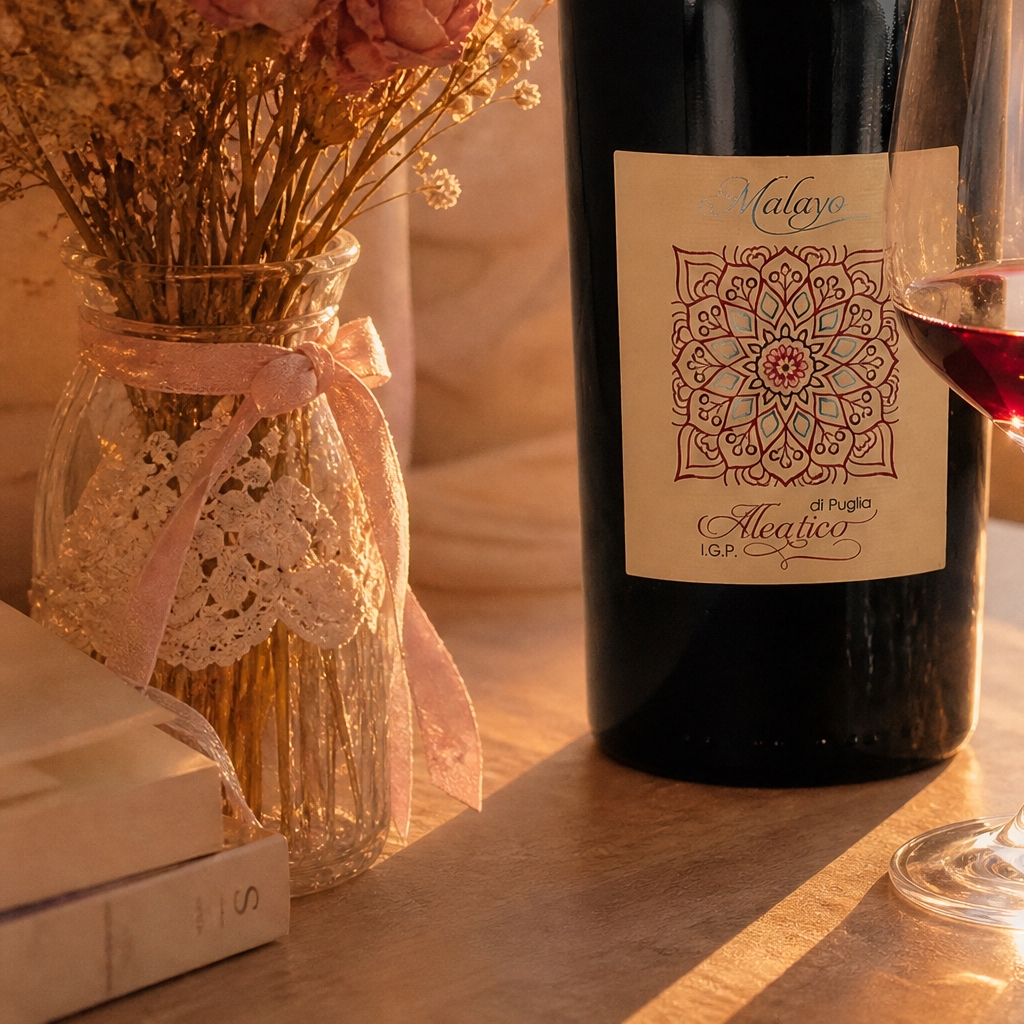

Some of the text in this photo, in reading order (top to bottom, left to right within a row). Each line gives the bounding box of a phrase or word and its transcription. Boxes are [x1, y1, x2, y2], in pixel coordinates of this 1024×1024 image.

[698, 175, 868, 236] Malayo
[809, 496, 872, 513] di Puglia
[697, 502, 878, 570] Aleatico
[701, 543, 738, 558] I.G.P.
